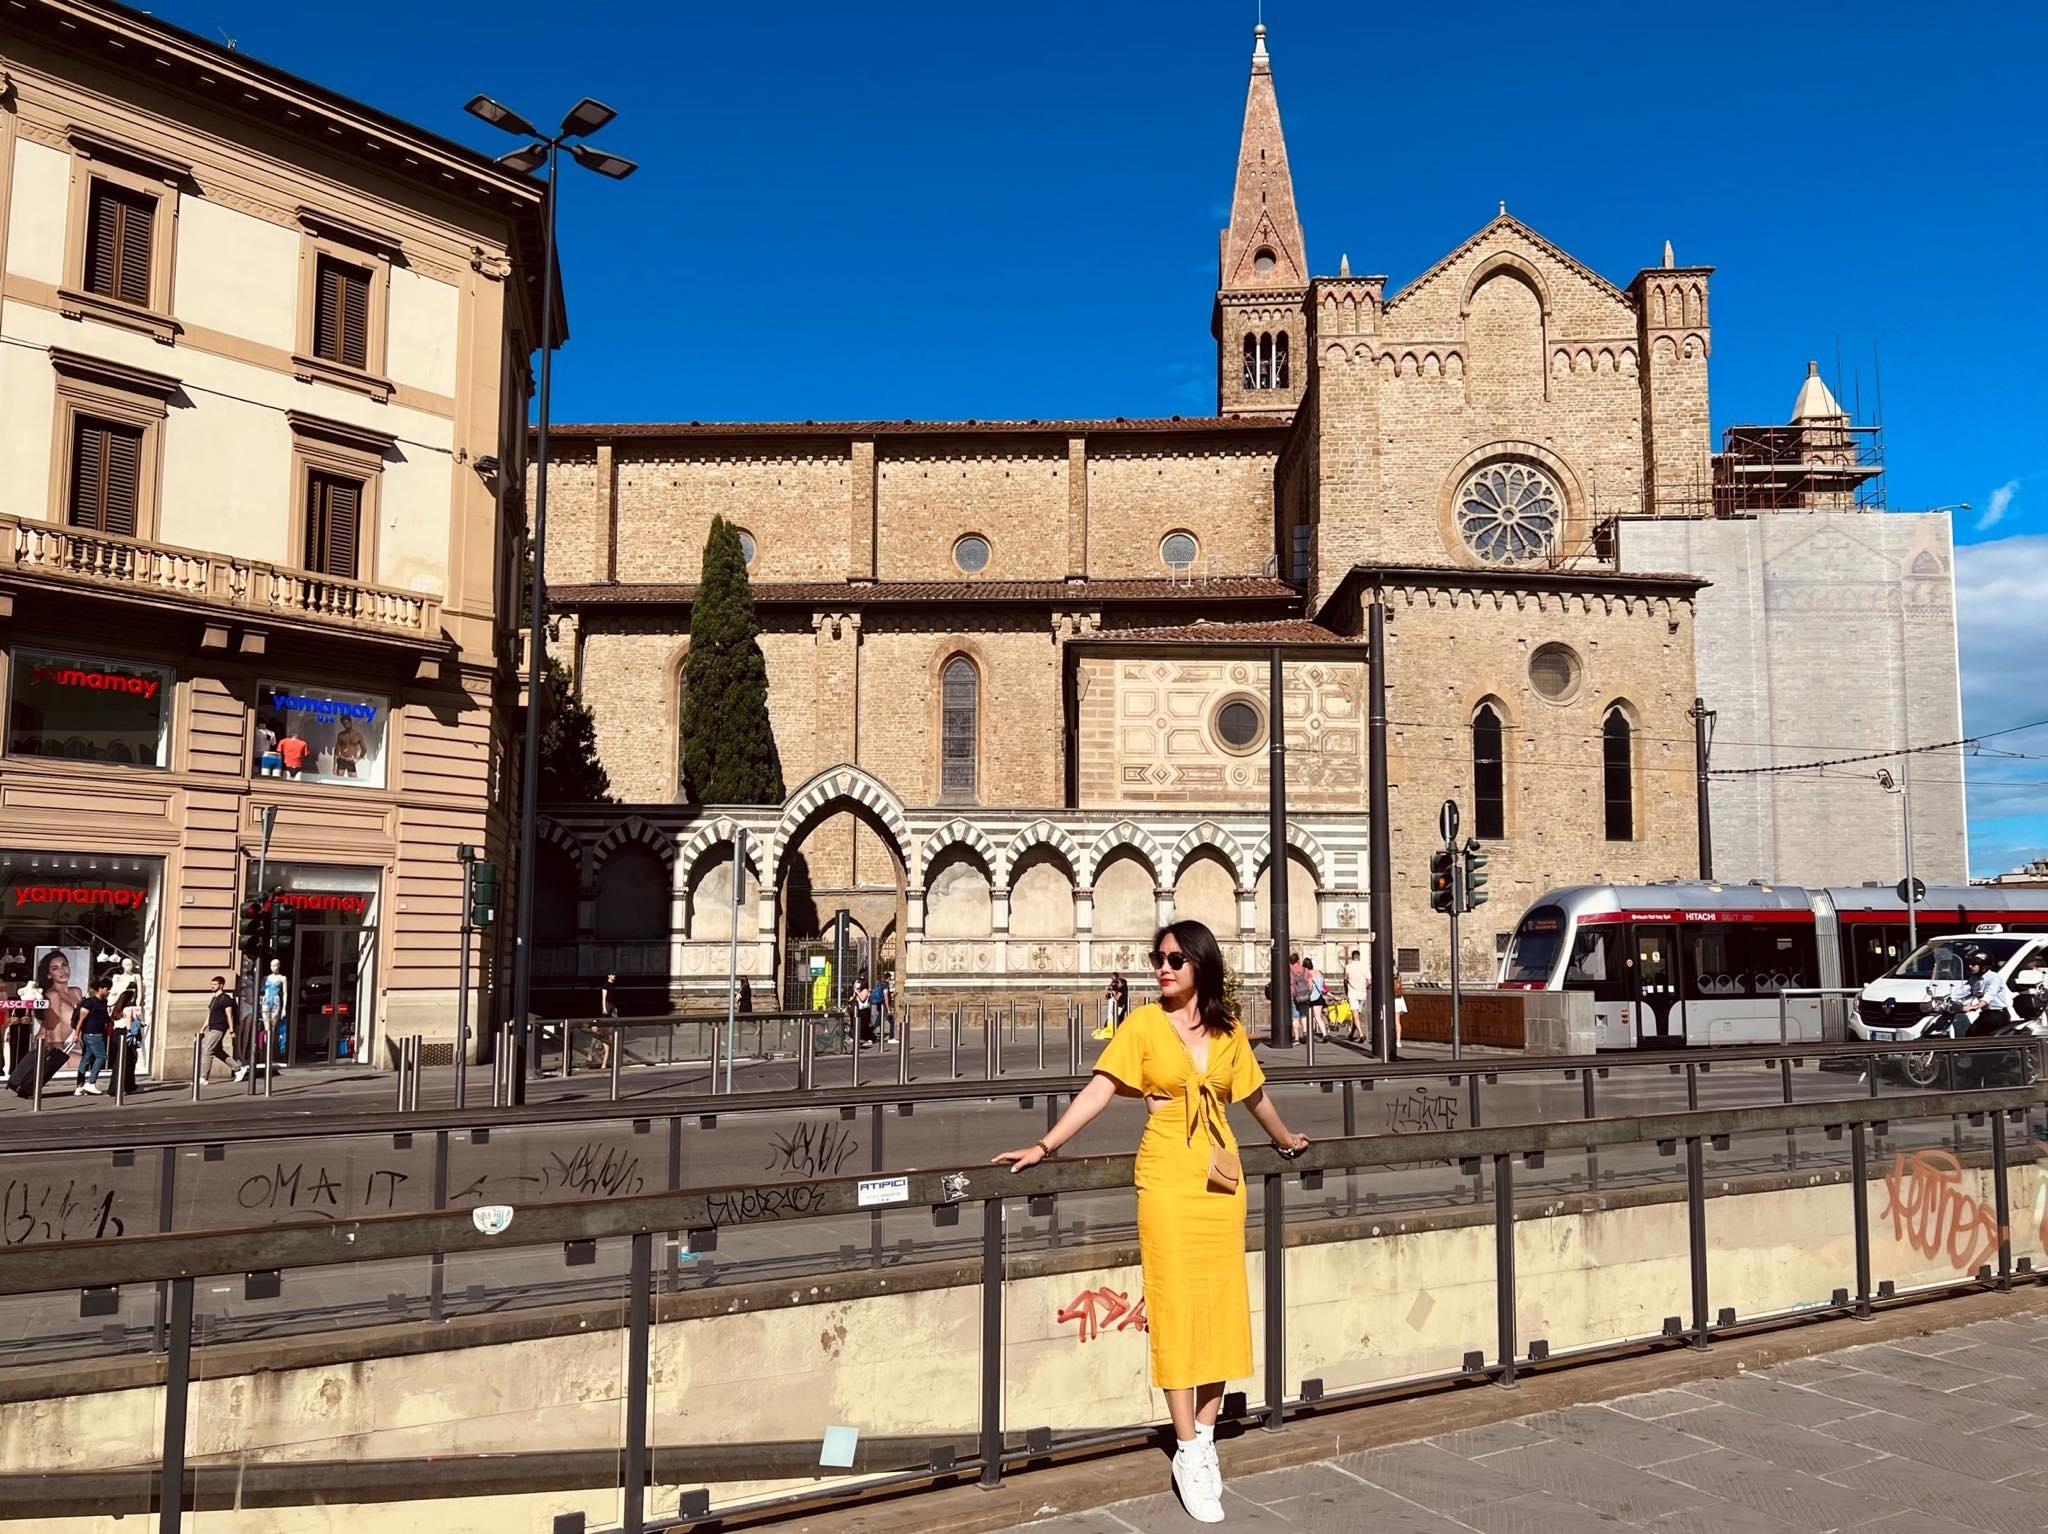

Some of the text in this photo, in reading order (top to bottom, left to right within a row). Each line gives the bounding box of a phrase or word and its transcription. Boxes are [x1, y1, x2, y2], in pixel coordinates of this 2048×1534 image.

[31, 666, 159, 699] mamay
[272, 694, 377, 724] yamamay
[15, 886, 145, 909] yamamay
[860, 1179, 906, 1191] ATIPICI
